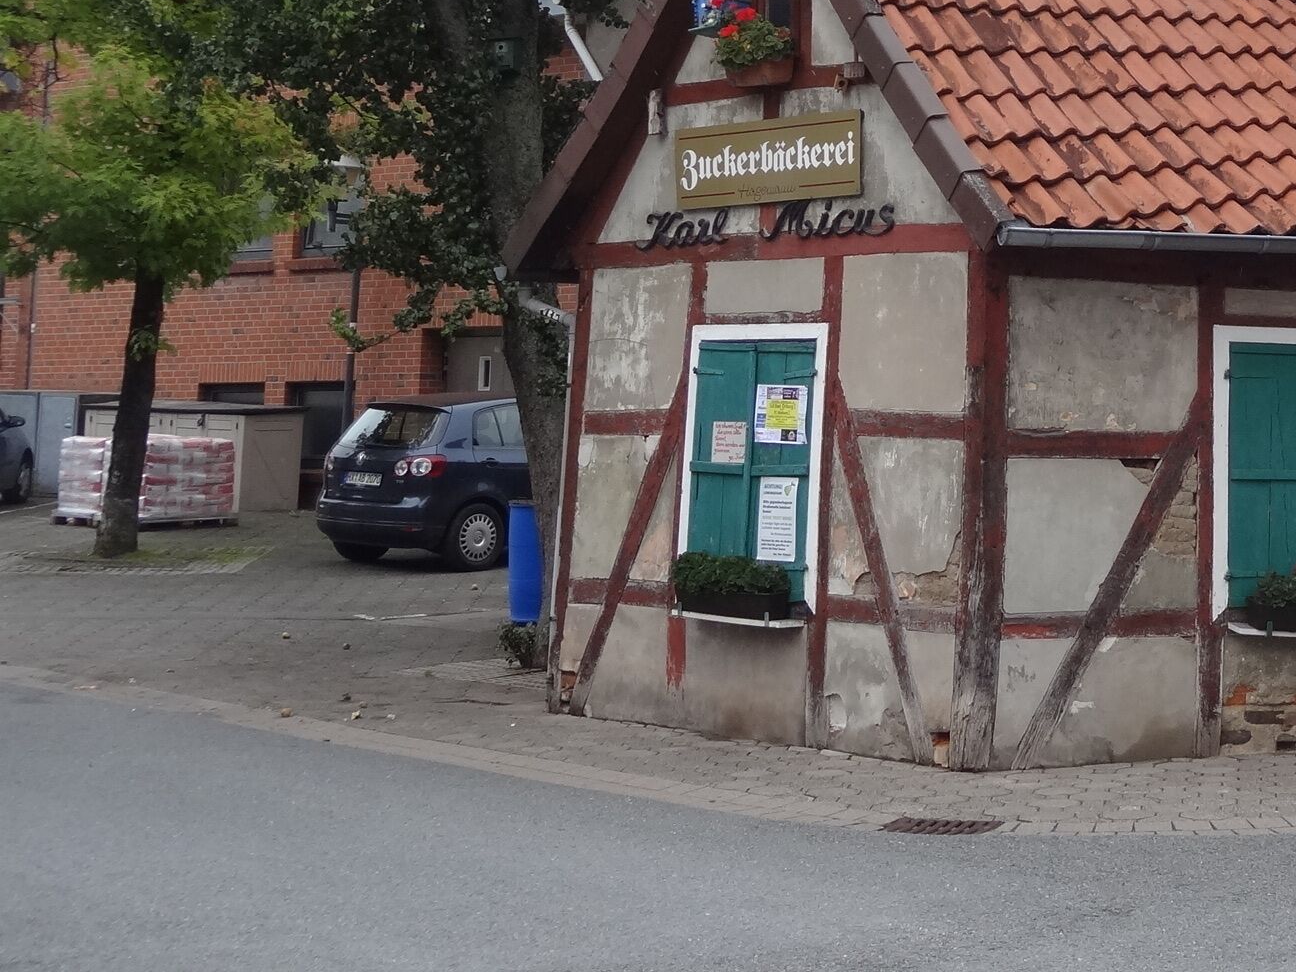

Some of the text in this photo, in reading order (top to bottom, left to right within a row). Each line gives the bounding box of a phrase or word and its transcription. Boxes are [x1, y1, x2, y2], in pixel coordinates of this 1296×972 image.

[681, 131, 855, 191] Zuckerbäckerei
[636, 200, 895, 251] Karl Micus
